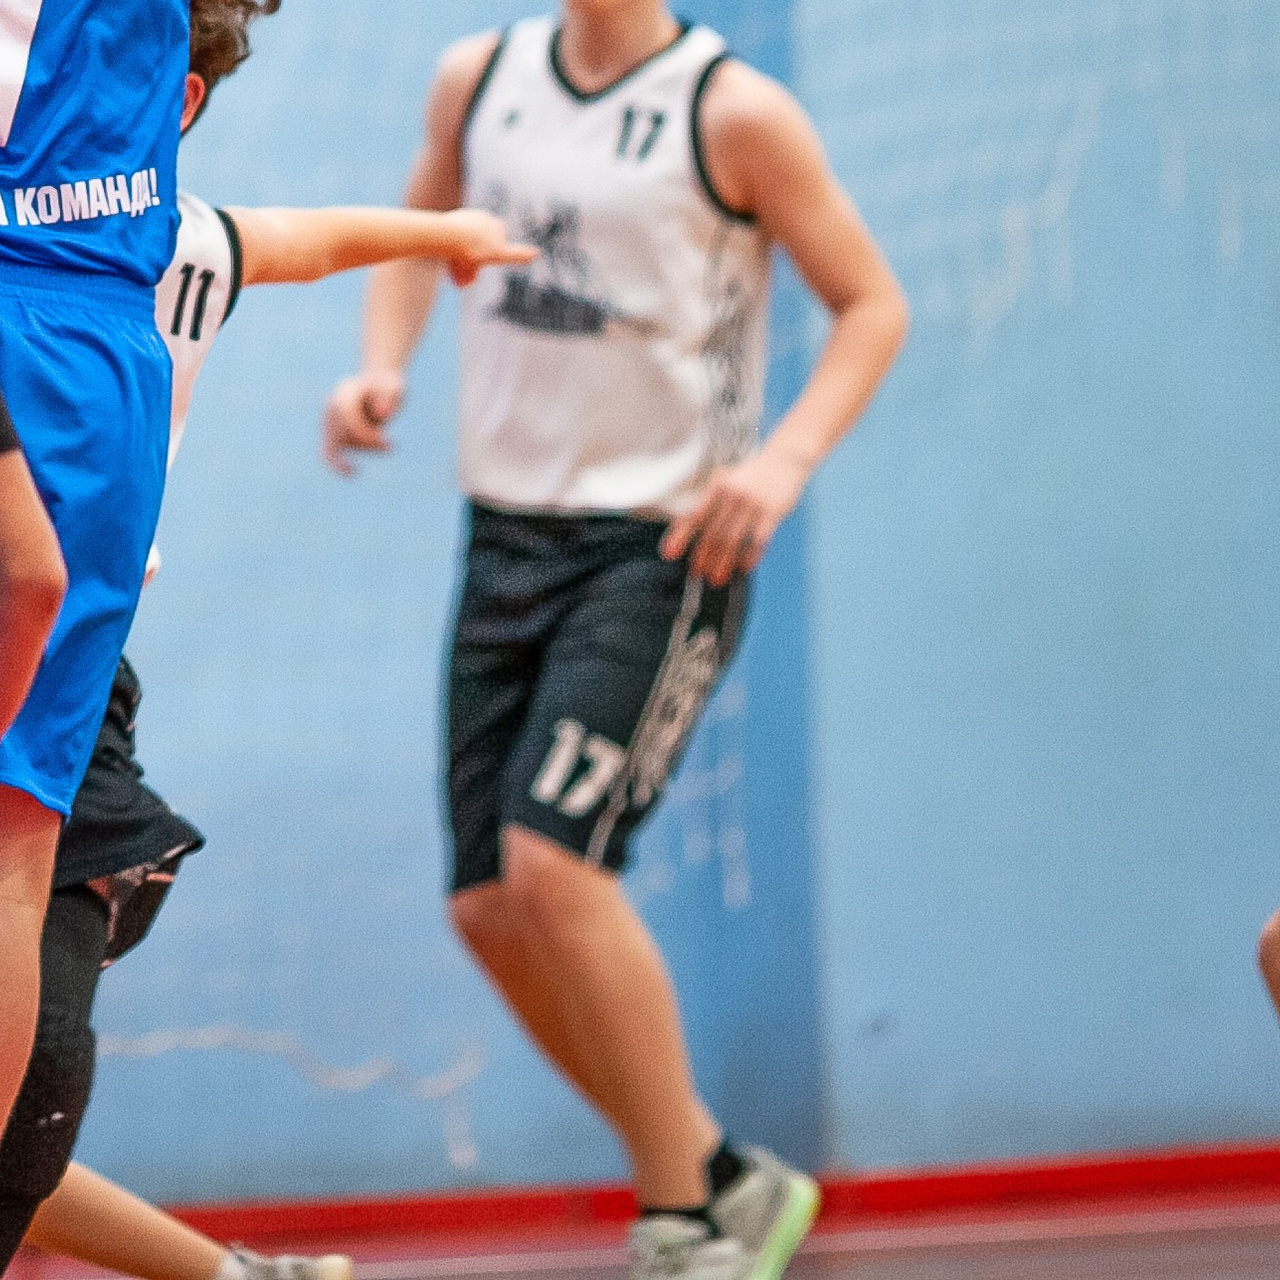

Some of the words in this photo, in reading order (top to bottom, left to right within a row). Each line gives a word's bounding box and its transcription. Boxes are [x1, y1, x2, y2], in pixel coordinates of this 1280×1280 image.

[616, 104, 666, 161] 17
[171, 262, 215, 341] 11
[531, 719, 625, 818] 17
